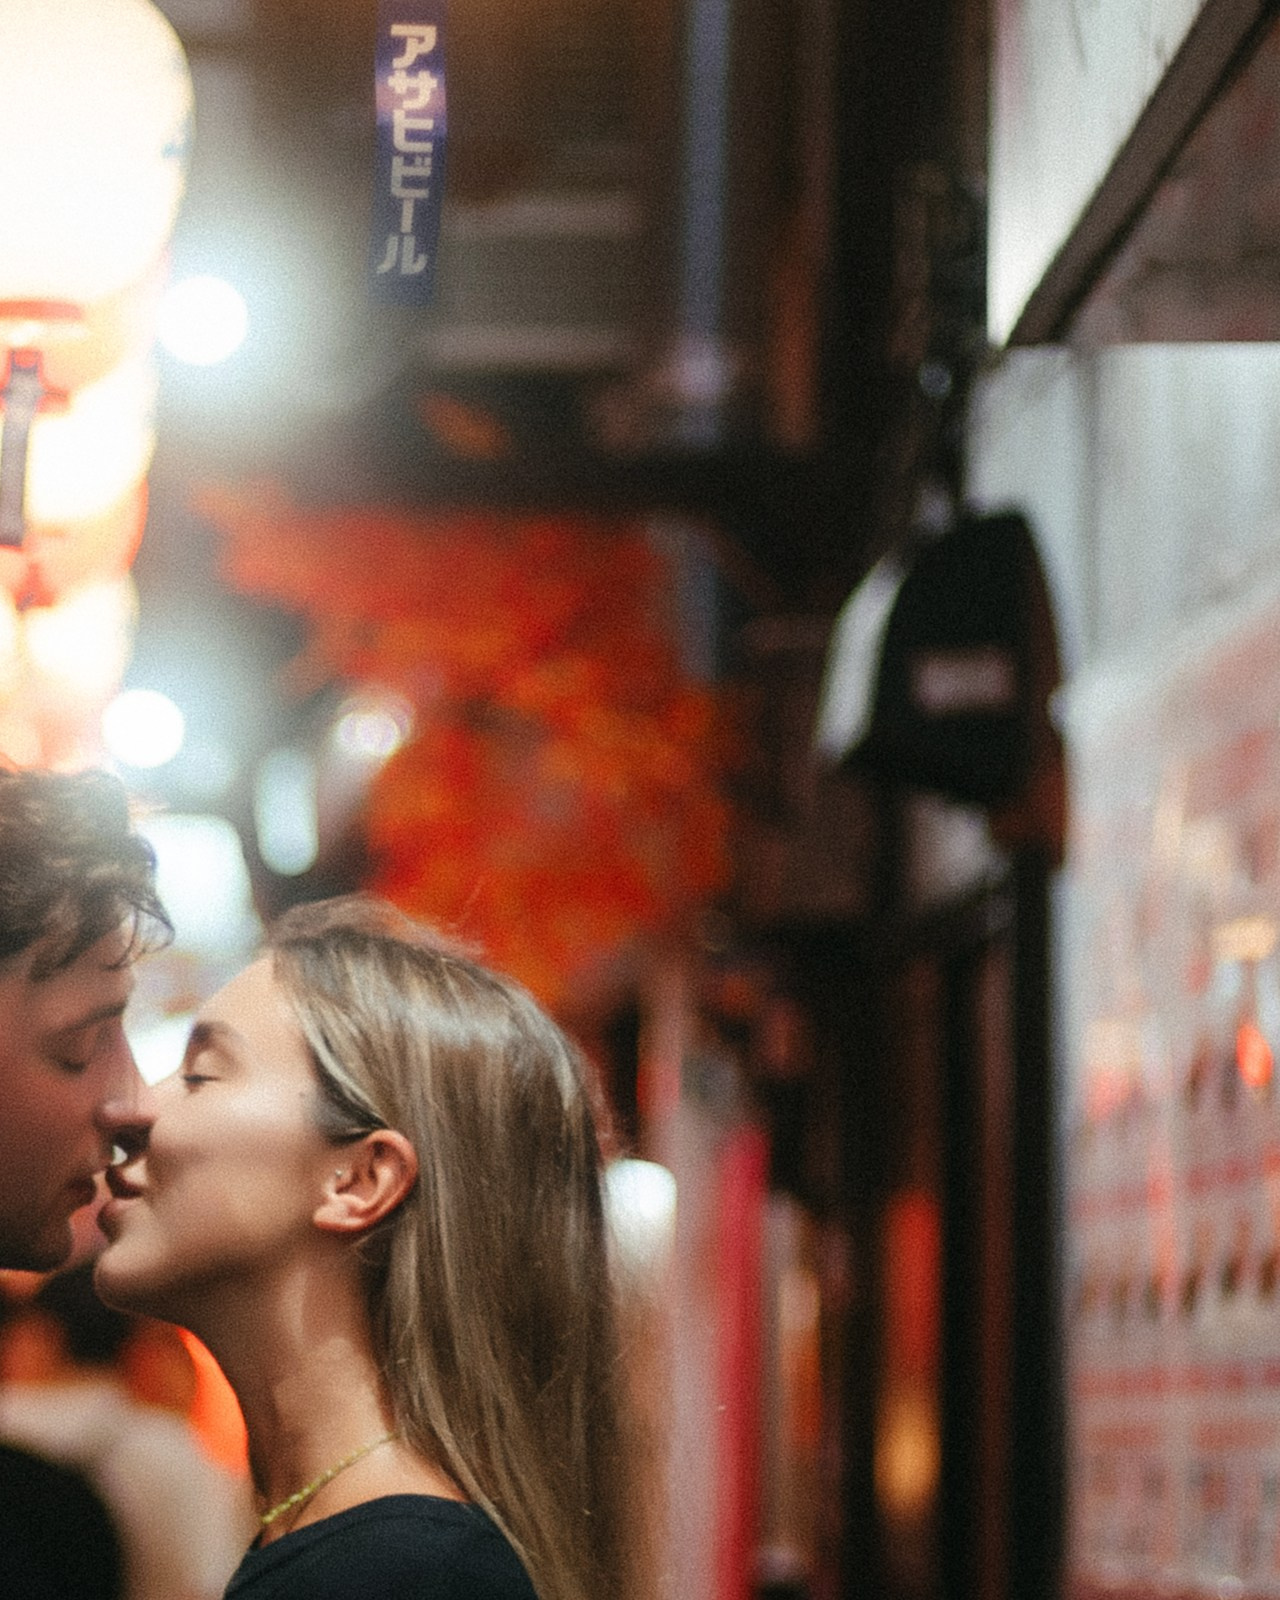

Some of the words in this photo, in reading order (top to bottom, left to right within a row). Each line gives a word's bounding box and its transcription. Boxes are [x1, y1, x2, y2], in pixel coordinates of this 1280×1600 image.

[376, 23, 438, 275] アサヒビール
